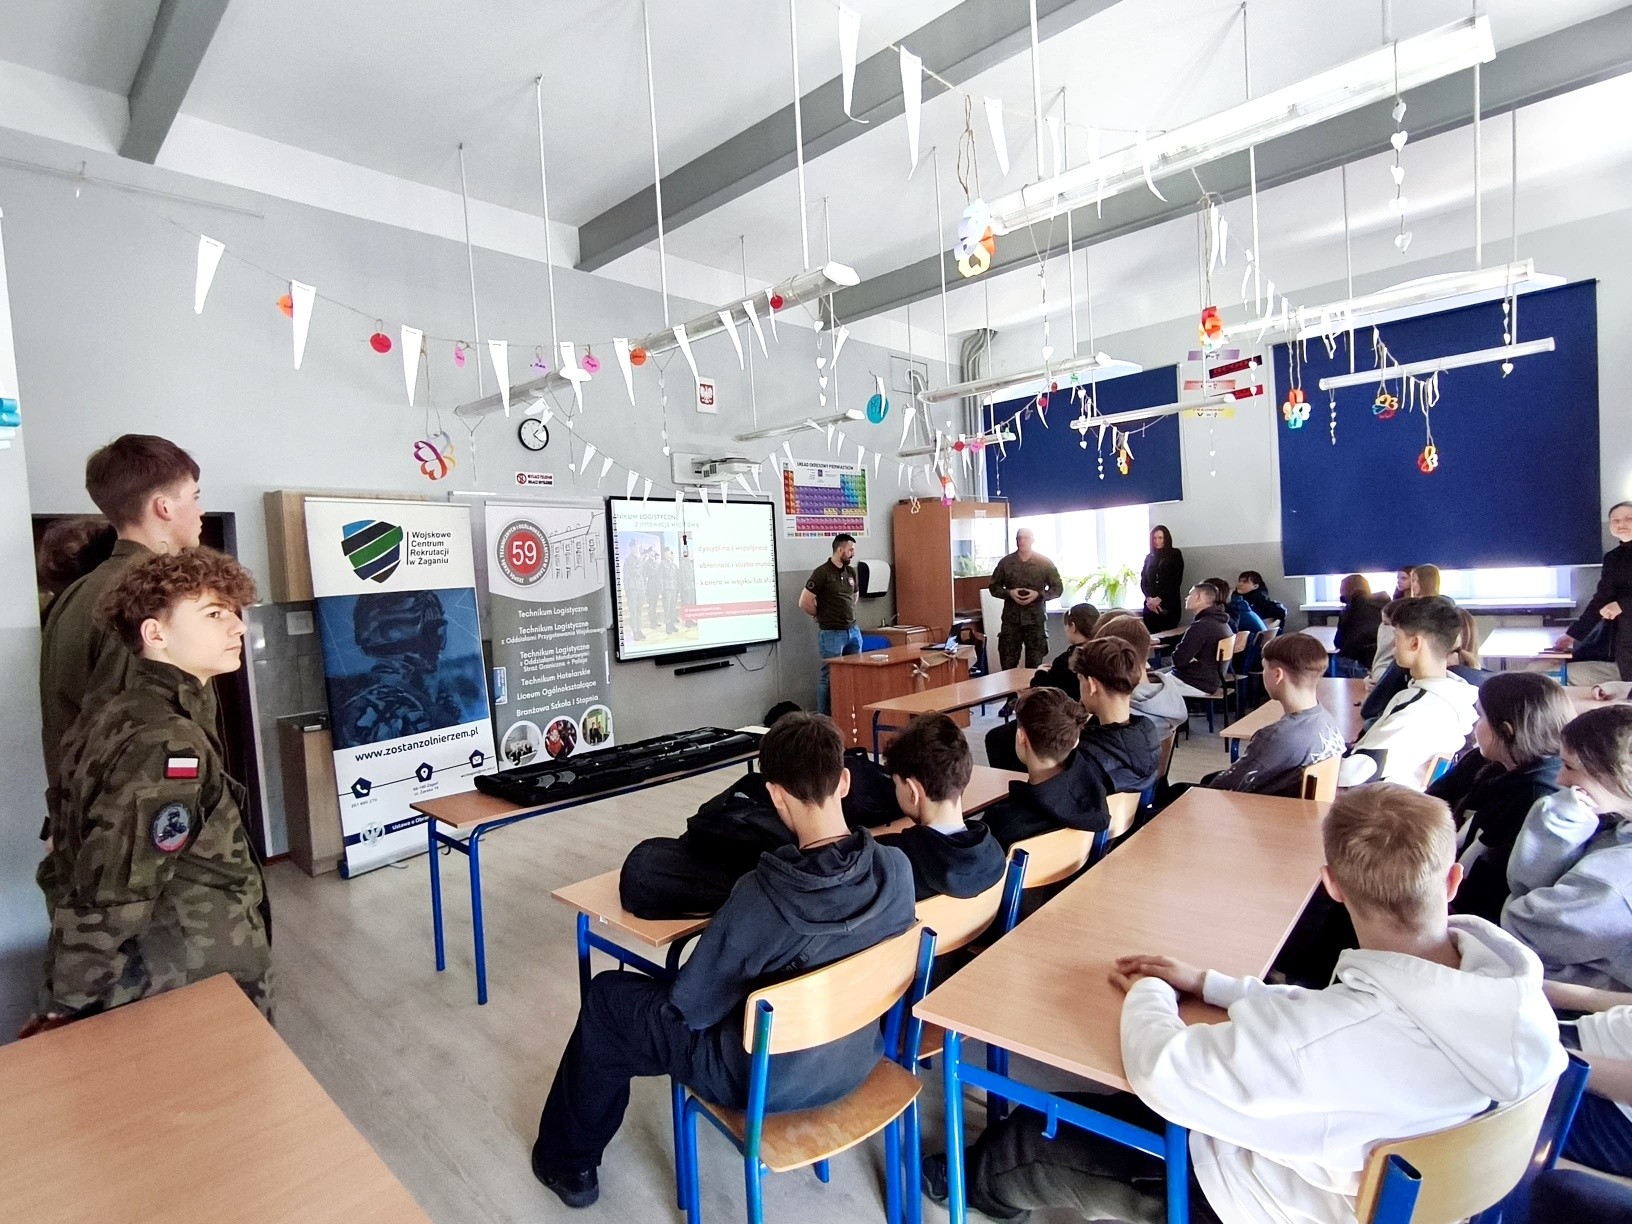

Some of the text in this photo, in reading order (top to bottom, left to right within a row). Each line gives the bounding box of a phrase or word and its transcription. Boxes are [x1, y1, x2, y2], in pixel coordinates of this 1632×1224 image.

[412, 531, 451, 540] Wojskowe
[410, 548, 449, 556] Rekrutacji
[512, 541, 537, 565] 59
[418, 558, 448, 566] Żaganiu
[518, 606, 588, 618] Technikum Logistyczne
[519, 621, 589, 634] Technikum Logistyczne
[520, 644, 590, 659] Technikum Logistyczne
[521, 668, 591, 686] Technikum Hotelarskie
[517, 681, 596, 700] Liceum Ogólnokształcące
[516, 706, 549, 716] Branżowa
[551, 700, 571, 710] Szkoła
[576, 695, 598, 705] Stopnia
[355, 727, 479, 762] www.zostanzolnierzem.pl
[392, 821, 410, 830] Ustawa
